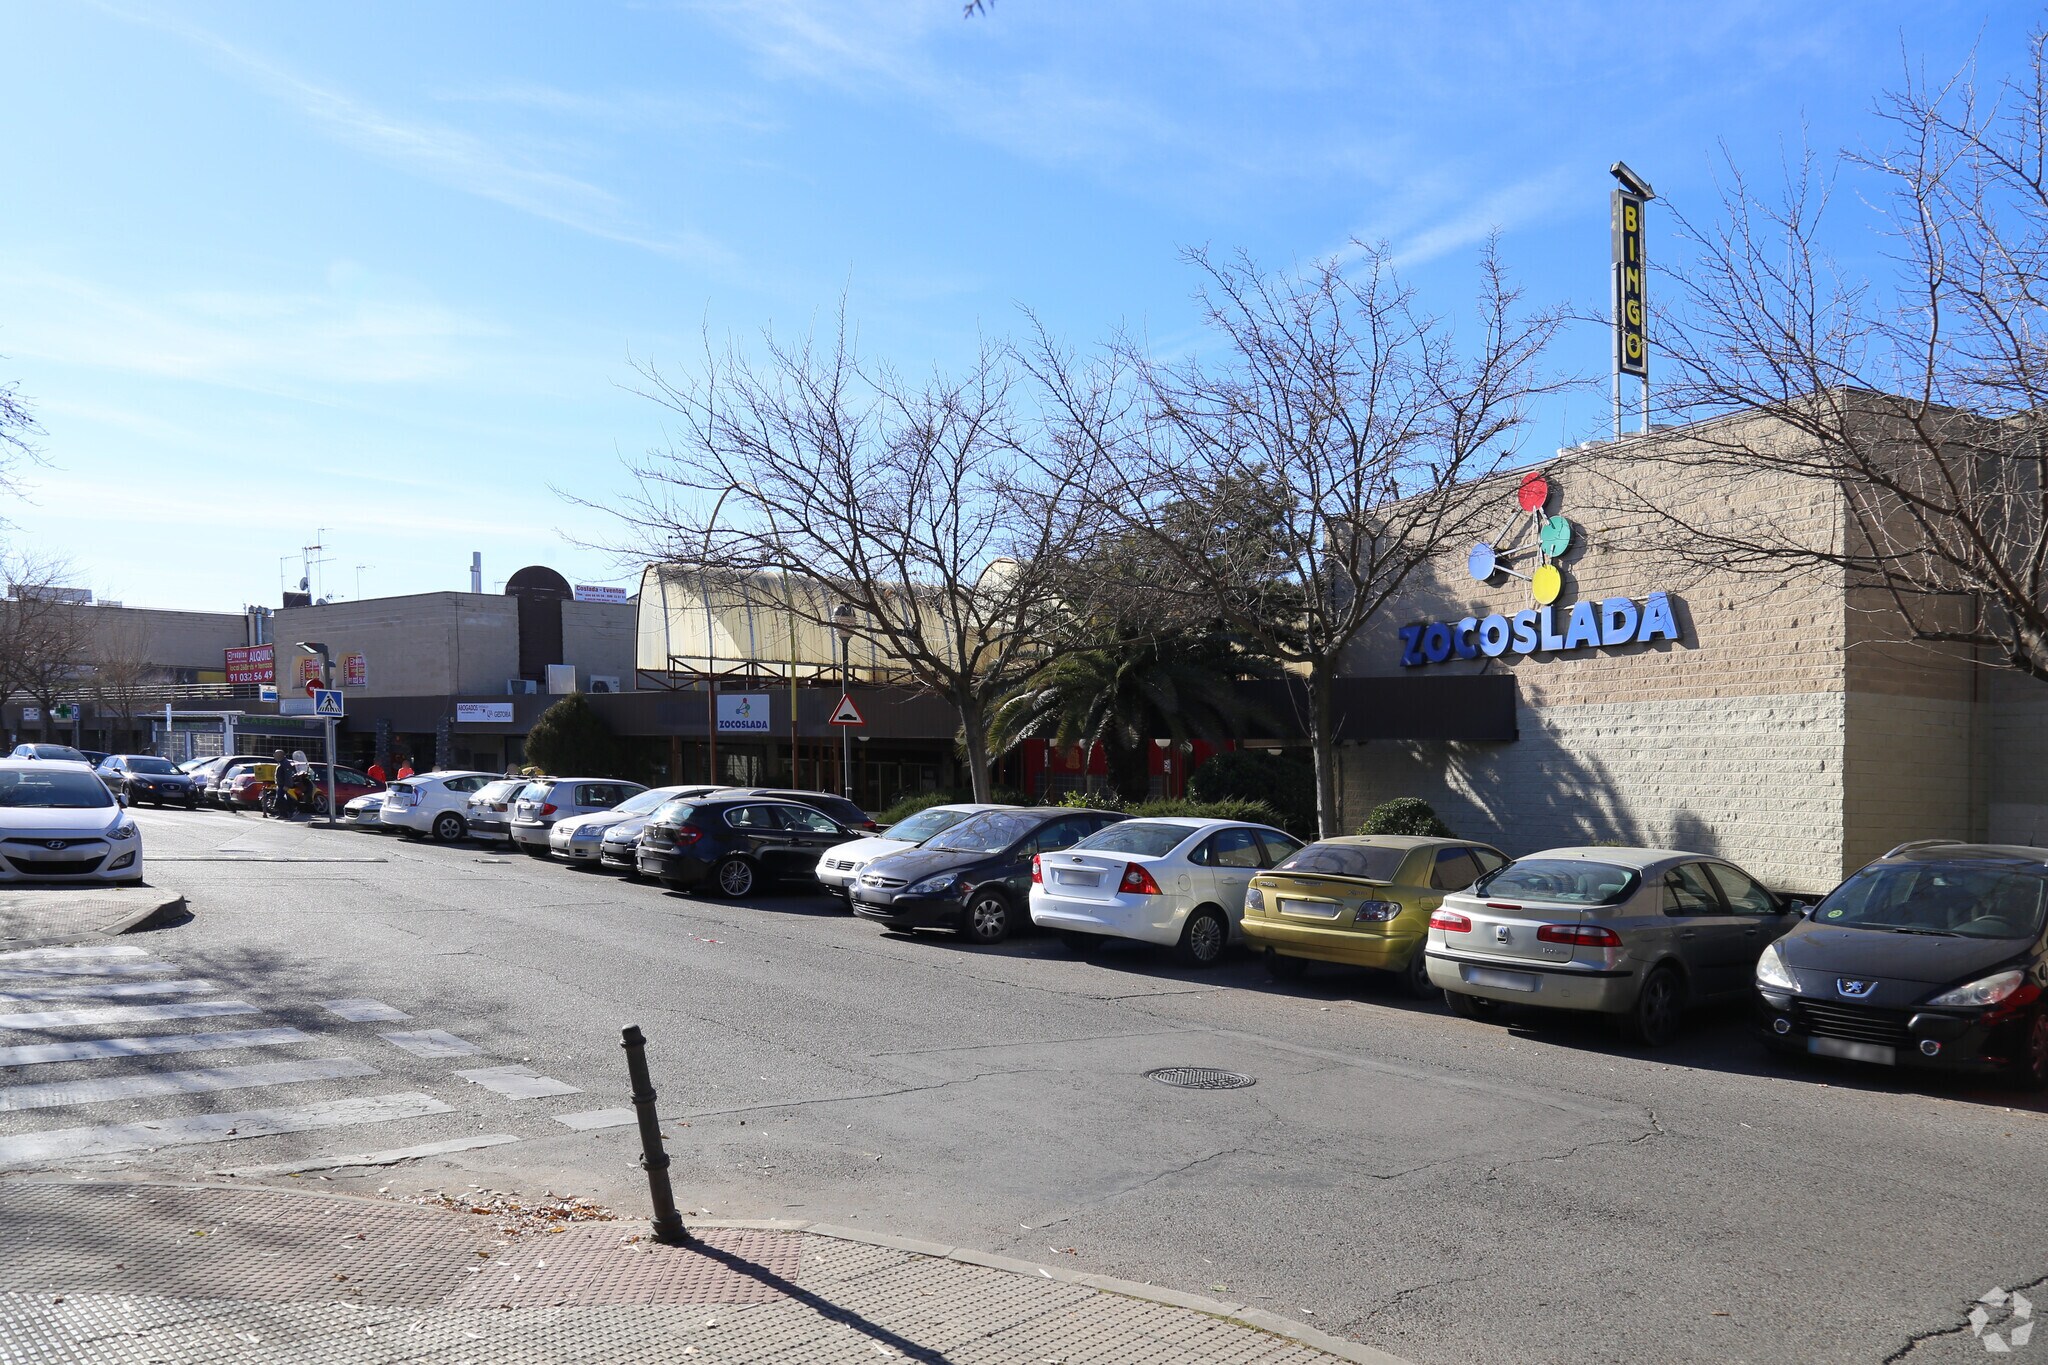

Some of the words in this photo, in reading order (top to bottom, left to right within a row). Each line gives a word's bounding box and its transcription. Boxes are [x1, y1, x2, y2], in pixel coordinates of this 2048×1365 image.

[1625, 206, 1641, 359] BINGO
[1399, 591, 1680, 667] ZOCOSLADA
[229, 673, 238, 682] 91
[239, 672, 252, 682] 032
[253, 671, 263, 681] 56
[264, 670, 273, 679] 49
